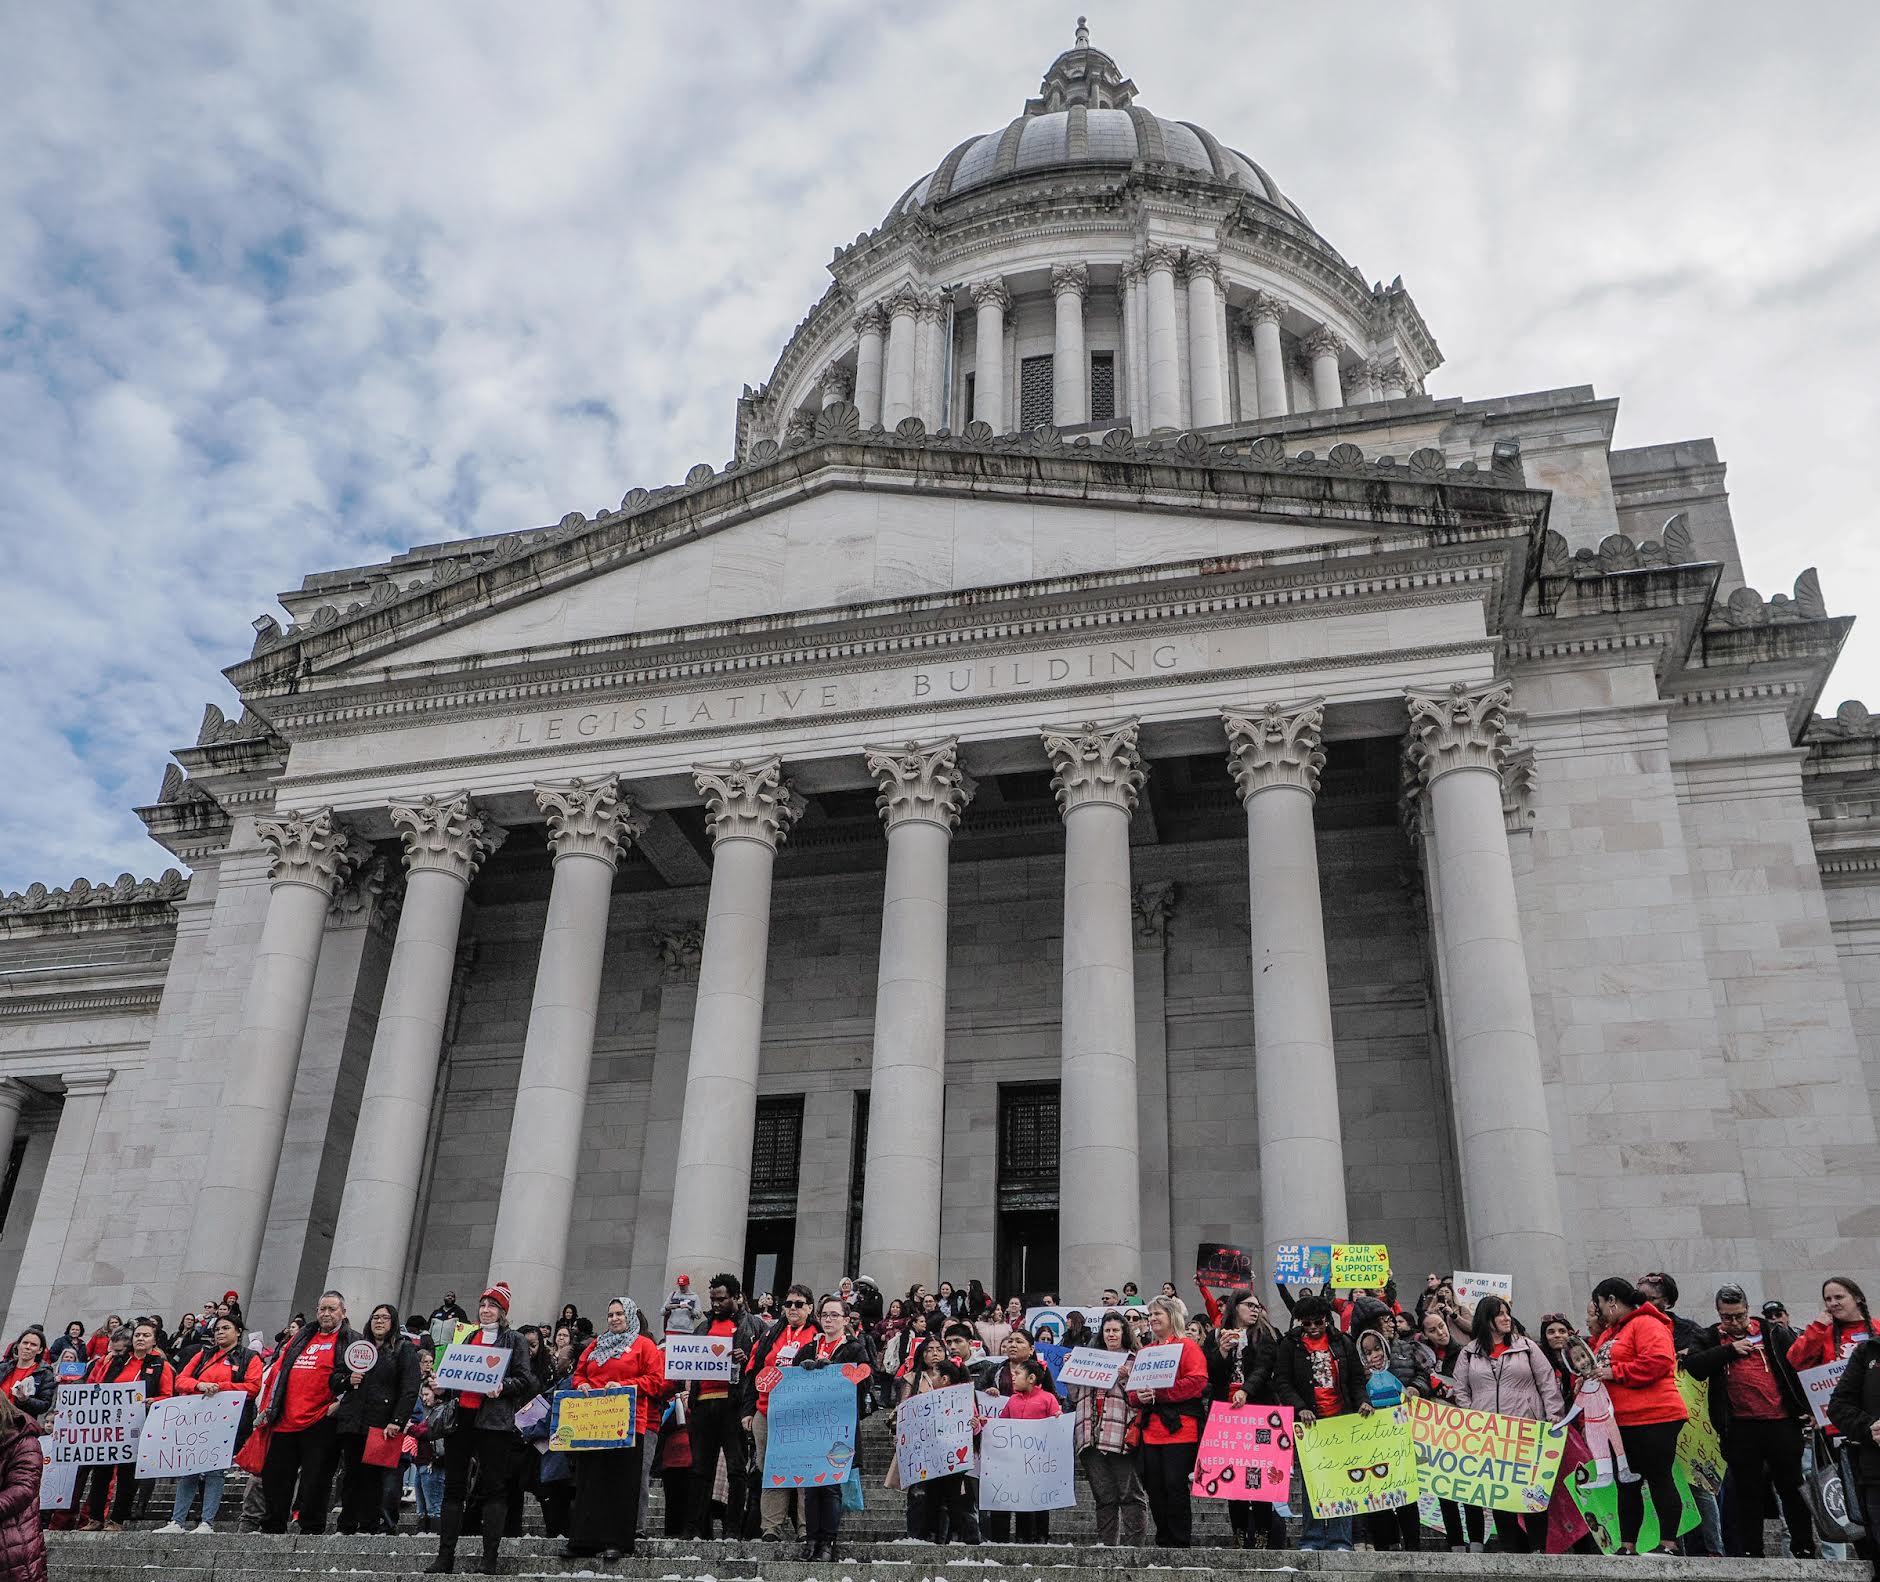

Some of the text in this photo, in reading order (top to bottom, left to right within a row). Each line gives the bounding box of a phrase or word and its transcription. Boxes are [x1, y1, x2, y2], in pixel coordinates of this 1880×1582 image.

[515, 645, 1181, 745] LEGISLATIVE BUILDING
[1278, 1245, 1299, 1254] OUR
[1302, 1245, 1311, 1269] ARE
[1348, 1246, 1370, 1254] OUR
[1277, 1254, 1300, 1263] KIDS
[1335, 1264, 1384, 1272] SUPPORTS
[1287, 1275, 1325, 1285] FUTURE
[1344, 1273, 1378, 1282] ECEAP
[673, 1345, 700, 1353] HAVE
[449, 1353, 475, 1363] HAVE
[668, 1360, 728, 1371] FOR KIDS!
[1072, 1358, 1095, 1367] INVEST
[1133, 1359, 1176, 1372] KIDS NEED
[438, 1368, 499, 1384] FOR KIDS!
[1066, 1367, 1112, 1382] FUTURE
[1828, 1364, 1847, 1376] FUN
[61, 1388, 136, 1406] SUPPORT
[596, 1397, 617, 1405] TODAY
[1688, 1381, 1709, 1430] hands
[76, 1409, 111, 1425] OUR
[163, 1405, 217, 1430] Para
[1218, 1414, 1265, 1426] FUTURE
[59, 1426, 125, 1444] FUTURE
[992, 1425, 1048, 1452] Show
[1218, 1431, 1229, 1440] IS
[1236, 1432, 1253, 1441] SO
[1304, 1420, 1407, 1453] Our Future
[1411, 1420, 1543, 1465] DVOCATE!
[55, 1444, 132, 1462] LEADERS
[1242, 1442, 1260, 1452] WE
[1306, 1437, 1413, 1472] is so bright
[159, 1446, 221, 1469] Niños
[1024, 1453, 1058, 1475] Kids
[1201, 1456, 1274, 1468] NEED SHADES
[1413, 1441, 1538, 1486] DVOCATE!
[991, 1482, 1060, 1505] You Care
[1310, 1481, 1335, 1503] We
[1339, 1475, 1376, 1497] need
[1417, 1469, 1509, 1508] ECEAP
